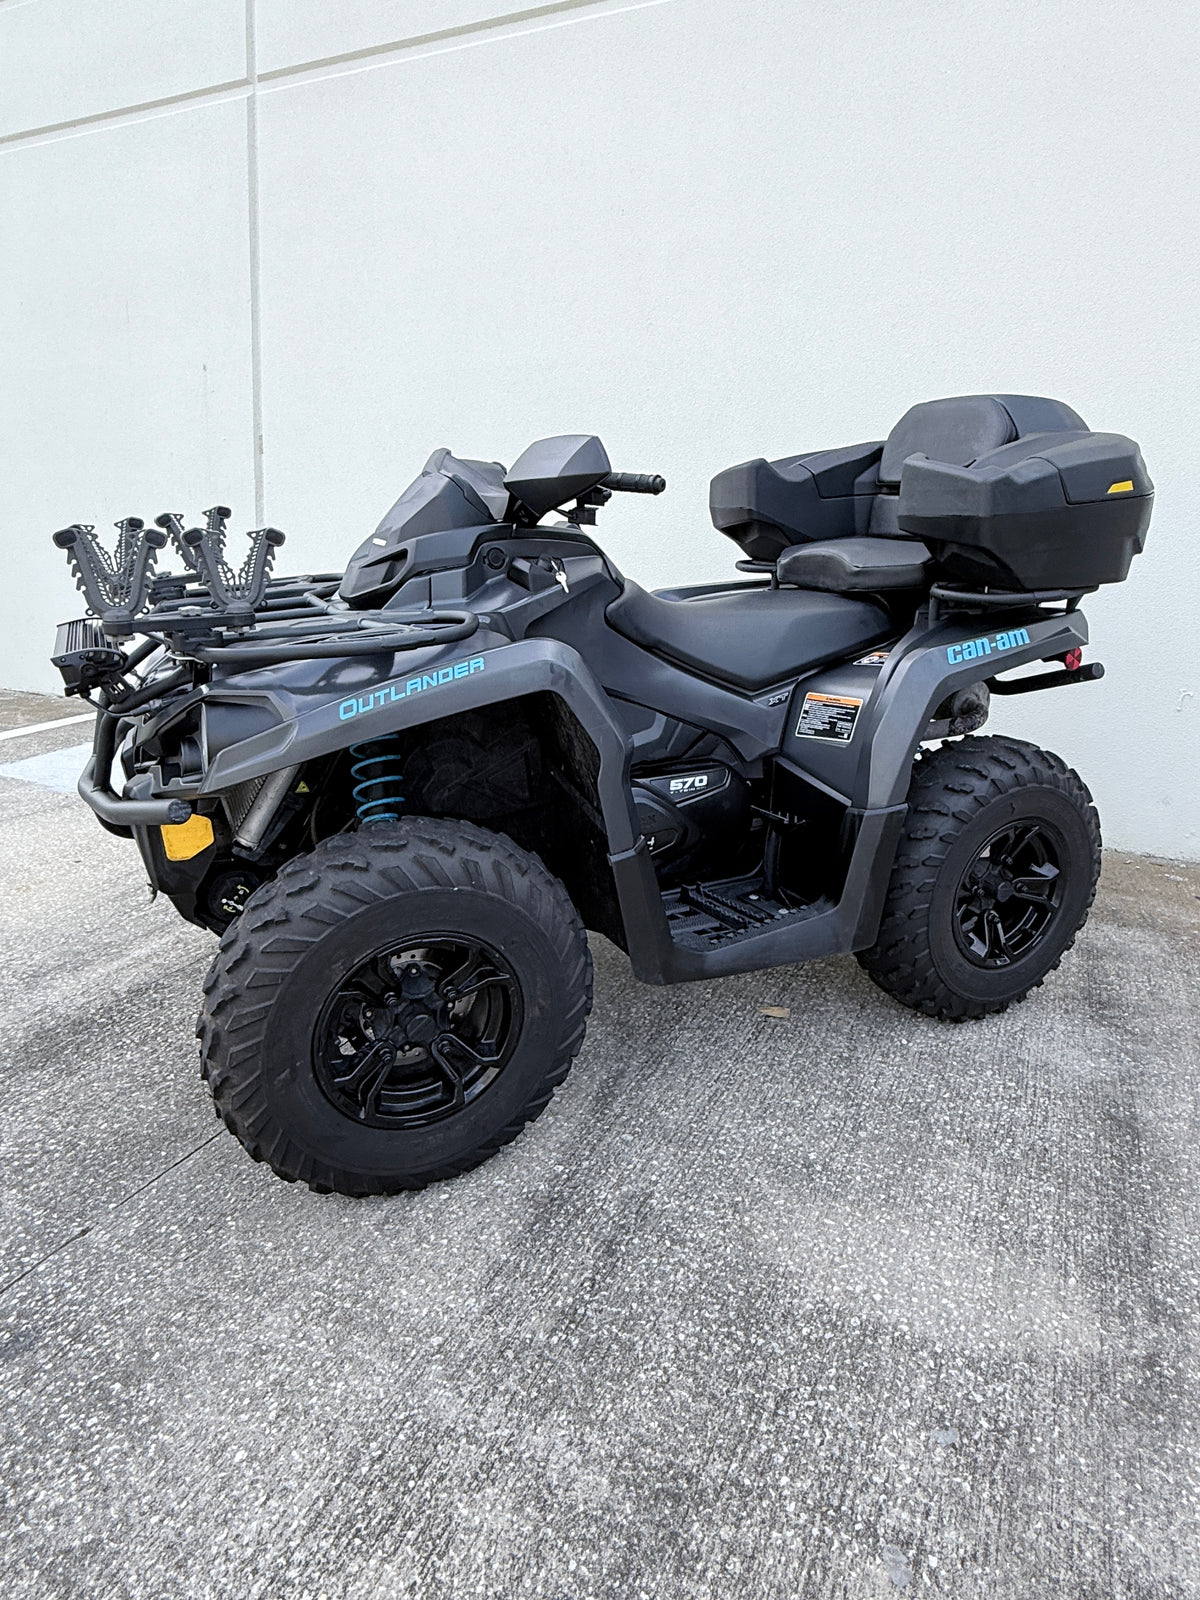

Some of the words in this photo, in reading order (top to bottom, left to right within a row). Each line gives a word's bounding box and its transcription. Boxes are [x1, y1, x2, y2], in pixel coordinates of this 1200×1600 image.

[946, 628, 1031, 665] can-am
[339, 657, 485, 720] OUTLANDER
[669, 775, 708, 791] 570
